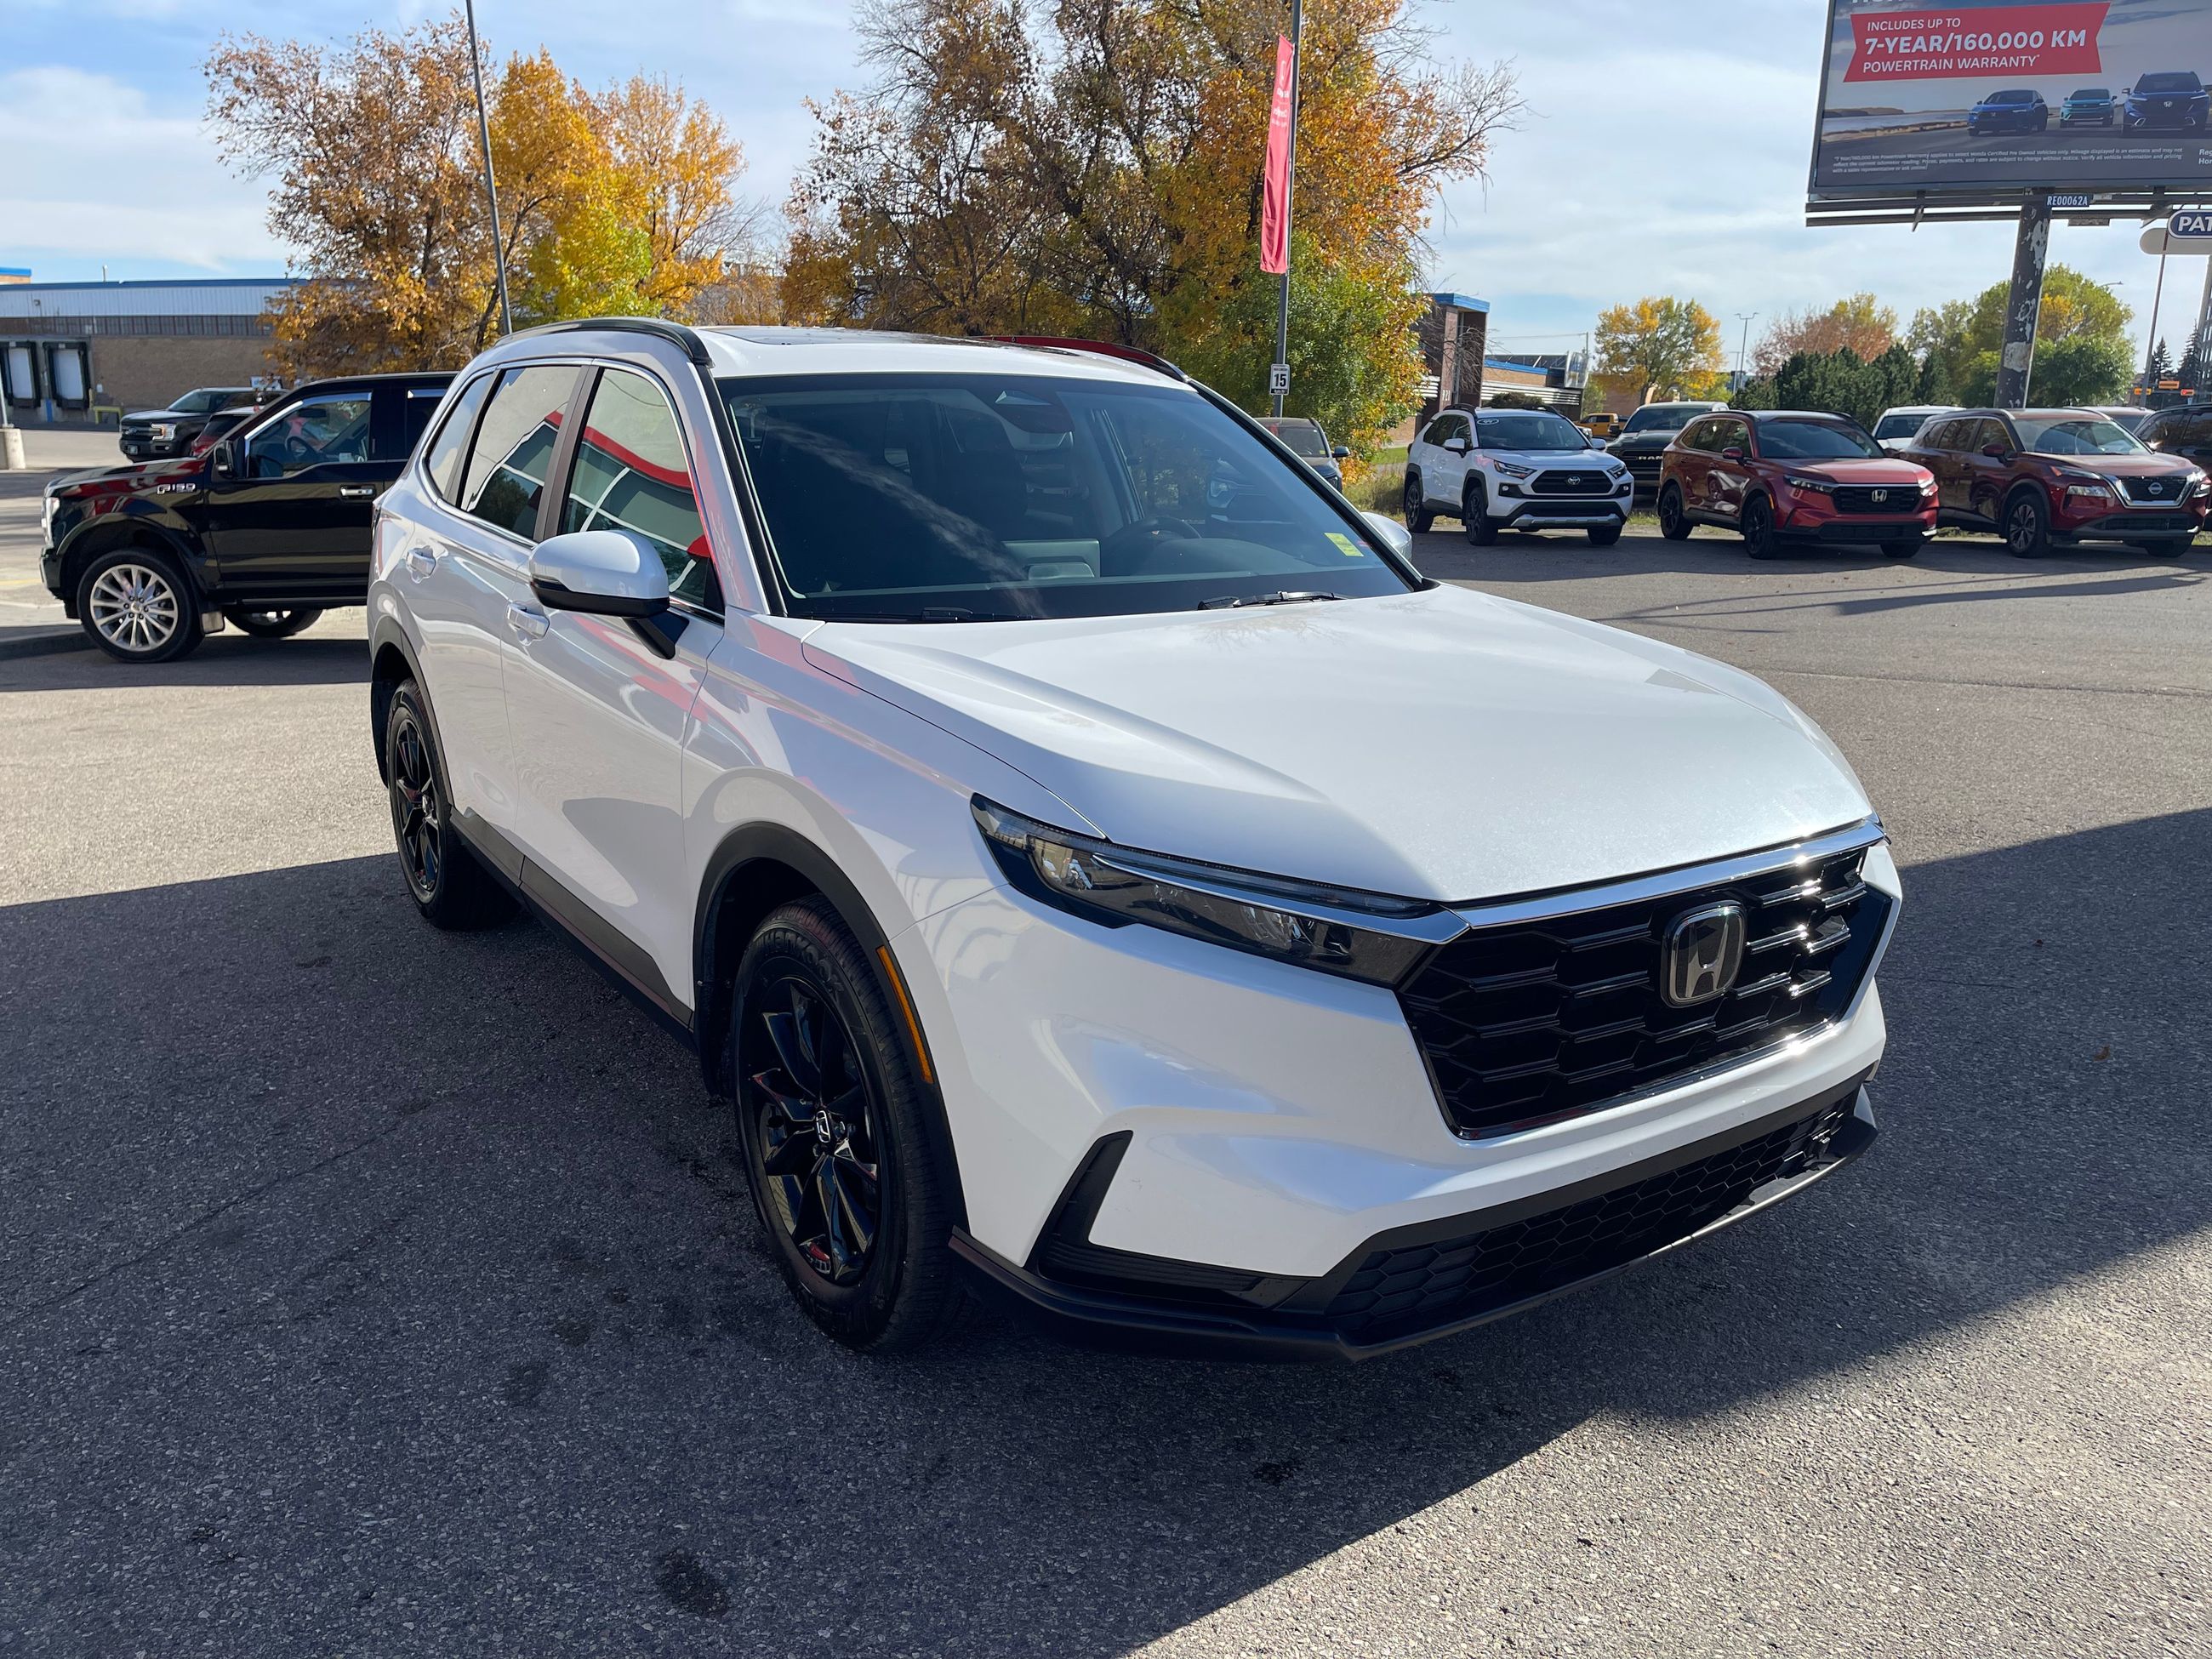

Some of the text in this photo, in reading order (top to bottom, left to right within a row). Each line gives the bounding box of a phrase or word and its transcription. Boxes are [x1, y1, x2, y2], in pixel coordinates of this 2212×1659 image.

[1867, 18, 1961, 31] INCLUDES UP TO
[1865, 29, 2087, 55] 7-YEAR/160,000 KM
[1863, 58, 1953, 73] POWERTRAIN
[2047, 196, 2088, 206] RE00062A
[2178, 216, 2212, 232] PAT
[1274, 373, 1286, 387] 15
